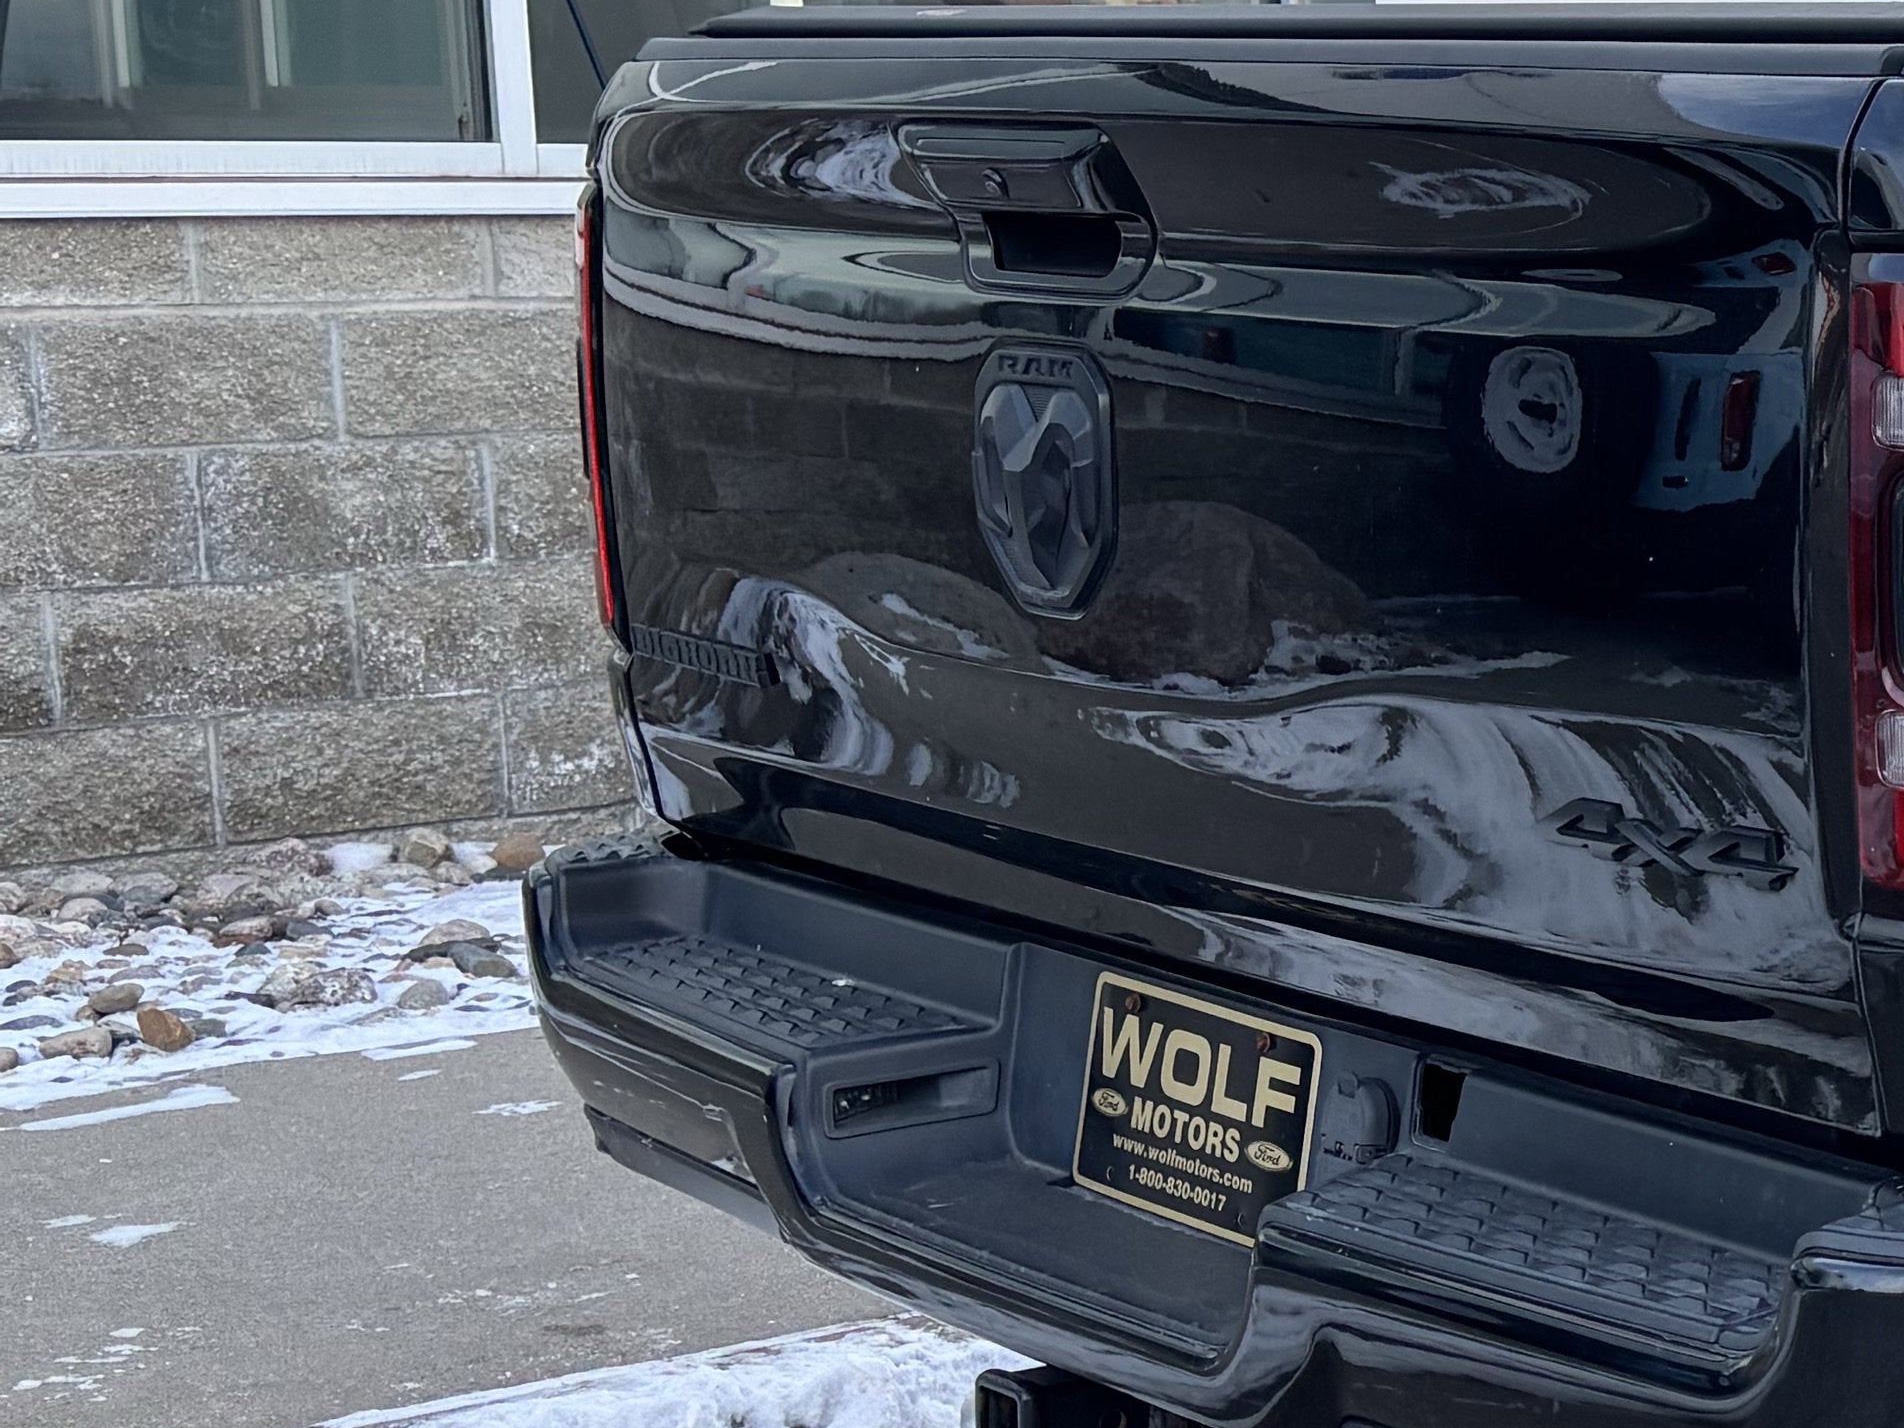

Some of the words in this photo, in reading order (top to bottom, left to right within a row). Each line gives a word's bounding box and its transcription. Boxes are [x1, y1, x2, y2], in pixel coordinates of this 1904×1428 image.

[998, 355, 1074, 380] RAM
[1101, 1005, 1302, 1128] WOLF
[1130, 1095, 1242, 1164] MOTORS
[1112, 1131, 1254, 1194] www.wolfmotors.com
[1128, 1164, 1227, 1212] 1-800-830-0017
